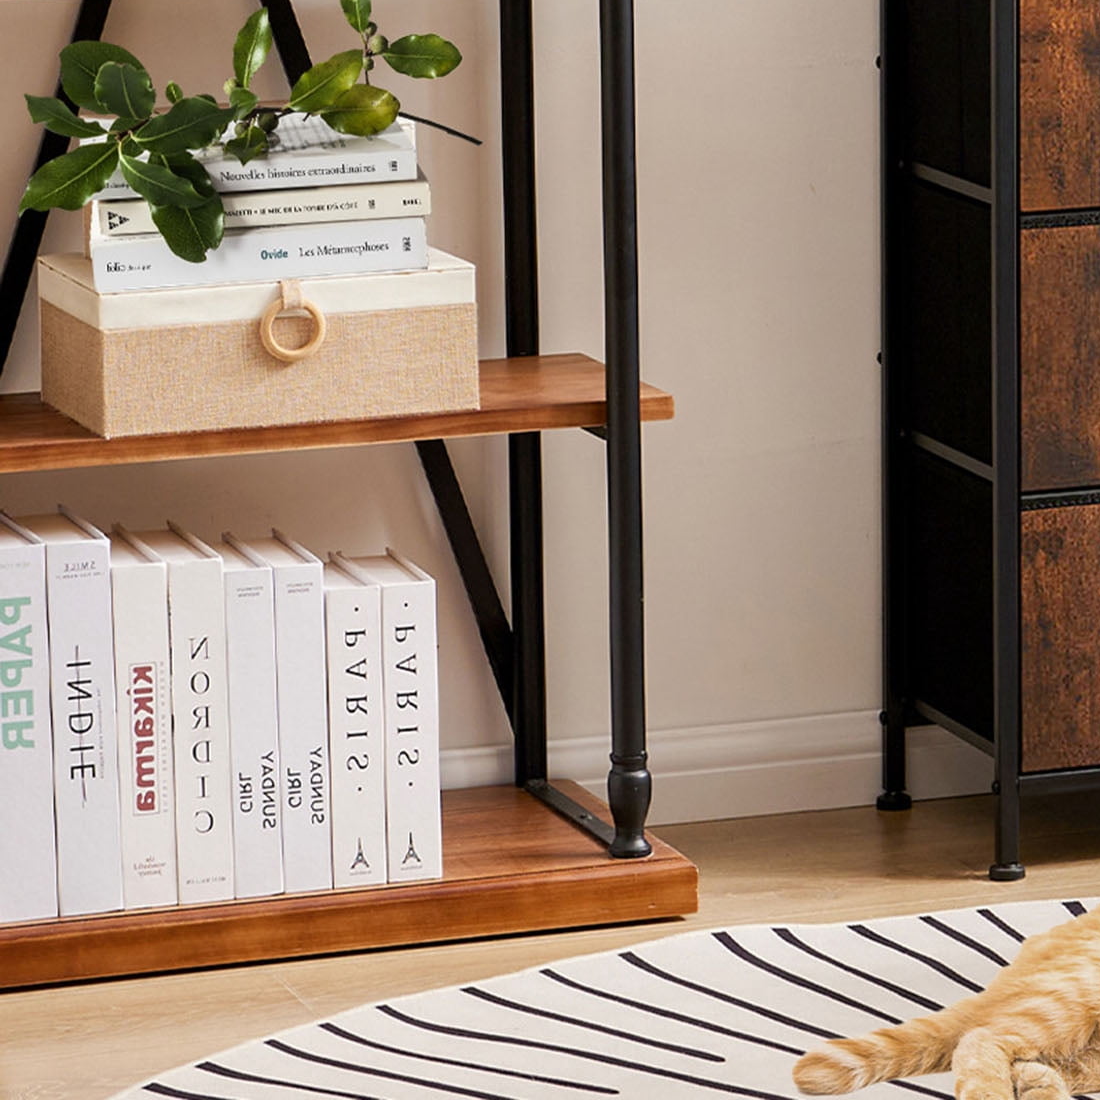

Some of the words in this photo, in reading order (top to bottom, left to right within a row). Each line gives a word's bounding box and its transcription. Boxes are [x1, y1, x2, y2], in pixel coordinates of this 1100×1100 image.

[219, 166, 266, 184] Nouvelles
[267, 165, 306, 179] histoires
[307, 161, 376, 177] extraordinaires
[260, 248, 289, 261] Ovide
[299, 246, 315, 258] Les
[316, 241, 390, 257] Métamorphoses
